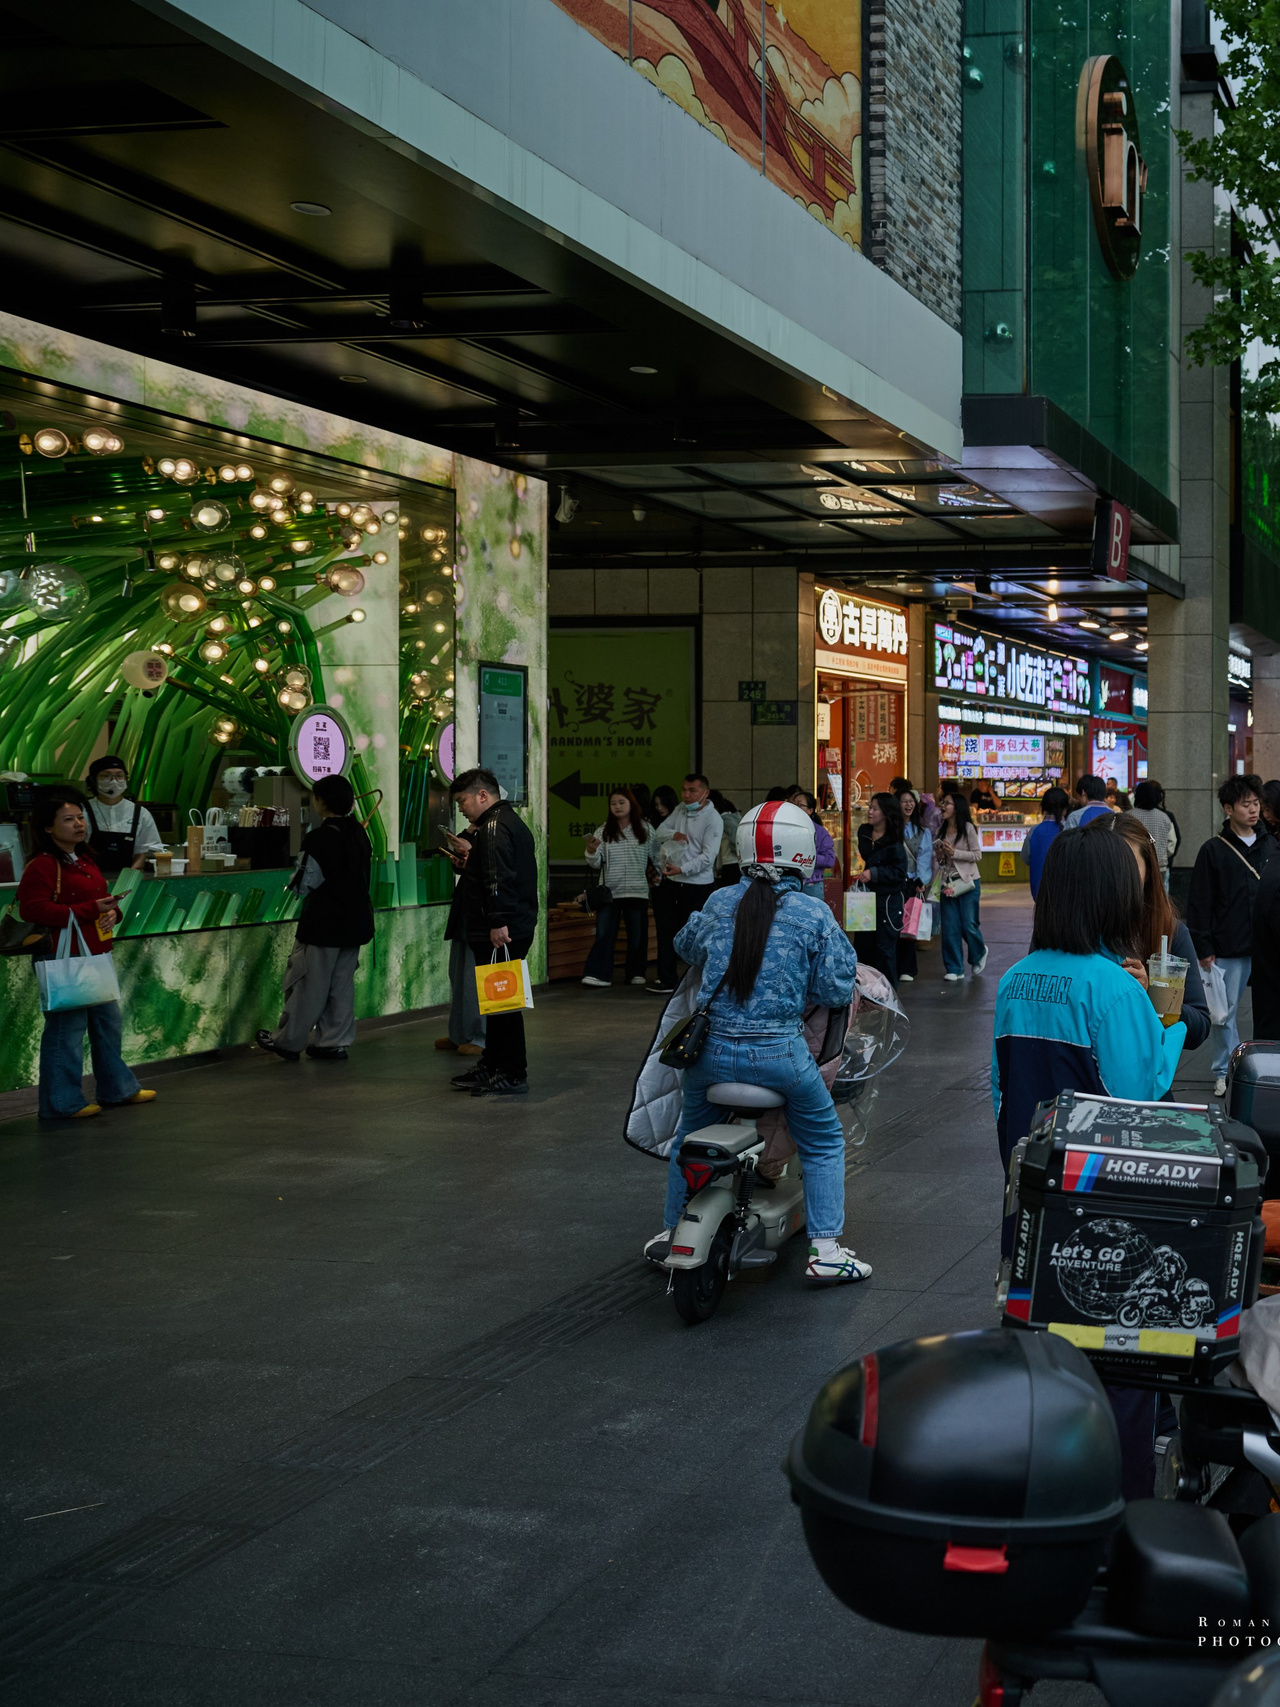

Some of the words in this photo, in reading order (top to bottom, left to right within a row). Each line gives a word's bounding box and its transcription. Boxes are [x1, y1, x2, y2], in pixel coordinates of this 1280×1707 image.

[1110, 512, 1123, 568] B
[550, 672, 662, 733] 婆家
[743, 690, 761, 699] 245
[550, 736, 613, 747] RANDMA'S
[617, 736, 653, 747] HOME
[1007, 973, 1072, 1005] JIANLAN
[1105, 1159, 1202, 1180] HQE-ADV
[1106, 1174, 1163, 1185] ALUMINUM
[1163, 1179, 1199, 1189] TRUNK
[1015, 1208, 1032, 1280] HQE-ADV
[1051, 1243, 1092, 1259] Let's
[1098, 1247, 1126, 1262] GO
[1049, 1258, 1122, 1272] ADVENTURE
[1229, 1231, 1245, 1299] HQE-ADV
[1087, 1354, 1158, 1366] DVENTURE
